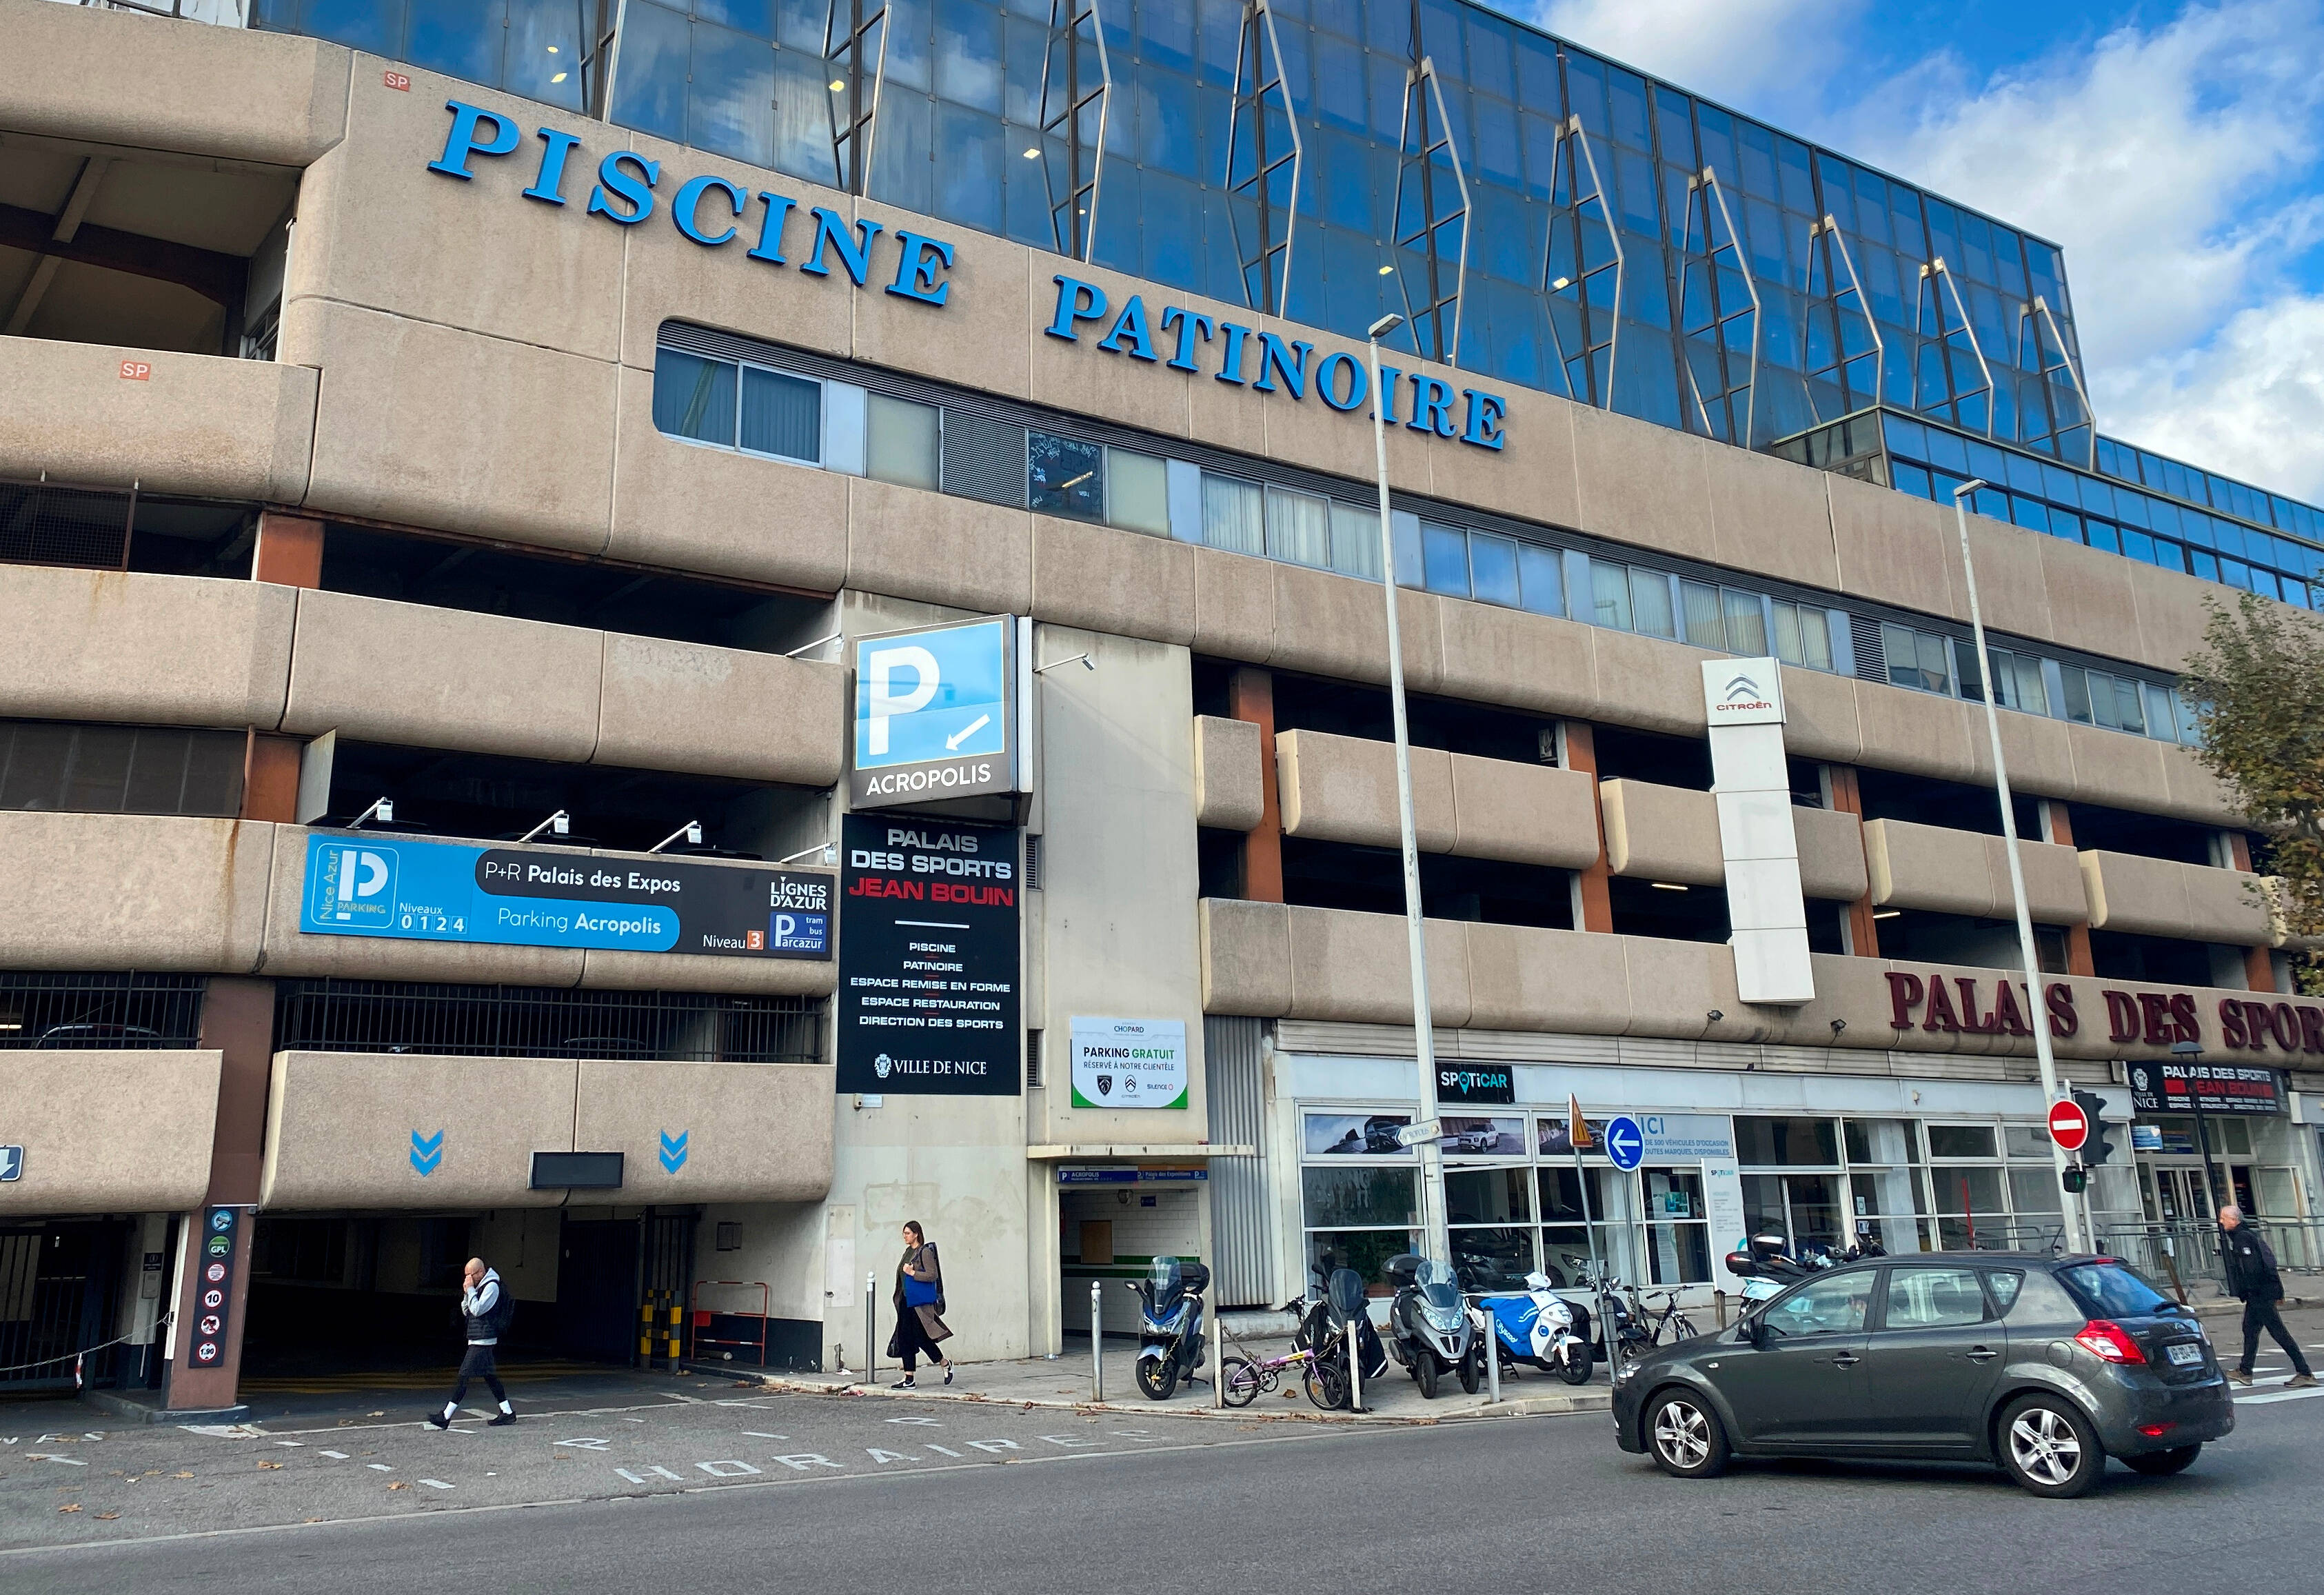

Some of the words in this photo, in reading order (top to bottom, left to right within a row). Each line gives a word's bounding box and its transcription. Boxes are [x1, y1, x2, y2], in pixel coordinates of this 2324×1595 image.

[387, 73, 407, 87] SP
[427, 99, 955, 307] PISCINE
[1044, 274, 1506, 451] PATINOIRE
[122, 363, 148, 378] SP
[869, 645, 940, 756] P
[1717, 701, 1772, 711] CITROËN
[866, 763, 991, 796] ACROPOLIS
[888, 829, 978, 852] PALAIS
[323, 850, 339, 884] Azur
[851, 850, 904, 872] DES
[912, 854, 1012, 879] SPORTS
[485, 862, 521, 881] P+R
[528, 865, 584, 885] Palais
[590, 870, 621, 888] des
[628, 872, 680, 894] Expos
[771, 876, 827, 897] LIGNES
[849, 877, 923, 900] JEAN
[931, 883, 1013, 906] BOUIN
[319, 887, 335, 920] Nice
[337, 901, 386, 914] PARKING
[400, 903, 443, 914] Niveaux
[770, 895, 827, 910] D'AZUR
[401, 915, 412, 928] 0
[421, 916, 427, 930] 1
[436, 918, 447, 931] 2
[453, 919, 464, 932] 4
[498, 907, 568, 932] Parking
[574, 913, 661, 936] Acropolis
[806, 916, 822, 925] tram
[809, 927, 822, 935] bus
[703, 934, 745, 949] Niveau
[751, 932, 760, 947] 3
[909, 942, 956, 953] PISCINE
[903, 961, 963, 972] PATINOIRE
[851, 978, 898, 987] ESPACE
[902, 979, 947, 990] REMISE
[951, 981, 967, 990] EN
[970, 983, 1010, 992] FORME
[862, 997, 909, 1007] ESPACE
[913, 999, 1000, 1010] RESTAURATION
[1885, 972, 2078, 1037] PALAS
[2102, 990, 2202, 1044] DES
[859, 1016, 924, 1027] DIRECTION
[928, 1017, 952, 1027] DES
[956, 1019, 1003, 1029] SPORTS
[1084, 1047, 1129, 1058] PARKING
[1132, 1049, 1174, 1059] GRATUIT
[894, 1060, 929, 1074] VILLE
[933, 1061, 951, 1075] DE
[955, 1061, 987, 1076] NICE
[2163, 1066, 2210, 1079] PALAIS
[2212, 1067, 2236, 1080] DES
[2237, 1069, 2271, 1081] SPORTS
[2188, 1081, 2225, 1095] EAN
[2133, 1096, 2159, 1108] NICE
[1641, 1117, 1664, 1134] ICI
[211, 1245, 226, 1254] GPL
[207, 1294, 219, 1303] 10
[614, 1429, 1158, 1484] HORAIRES
